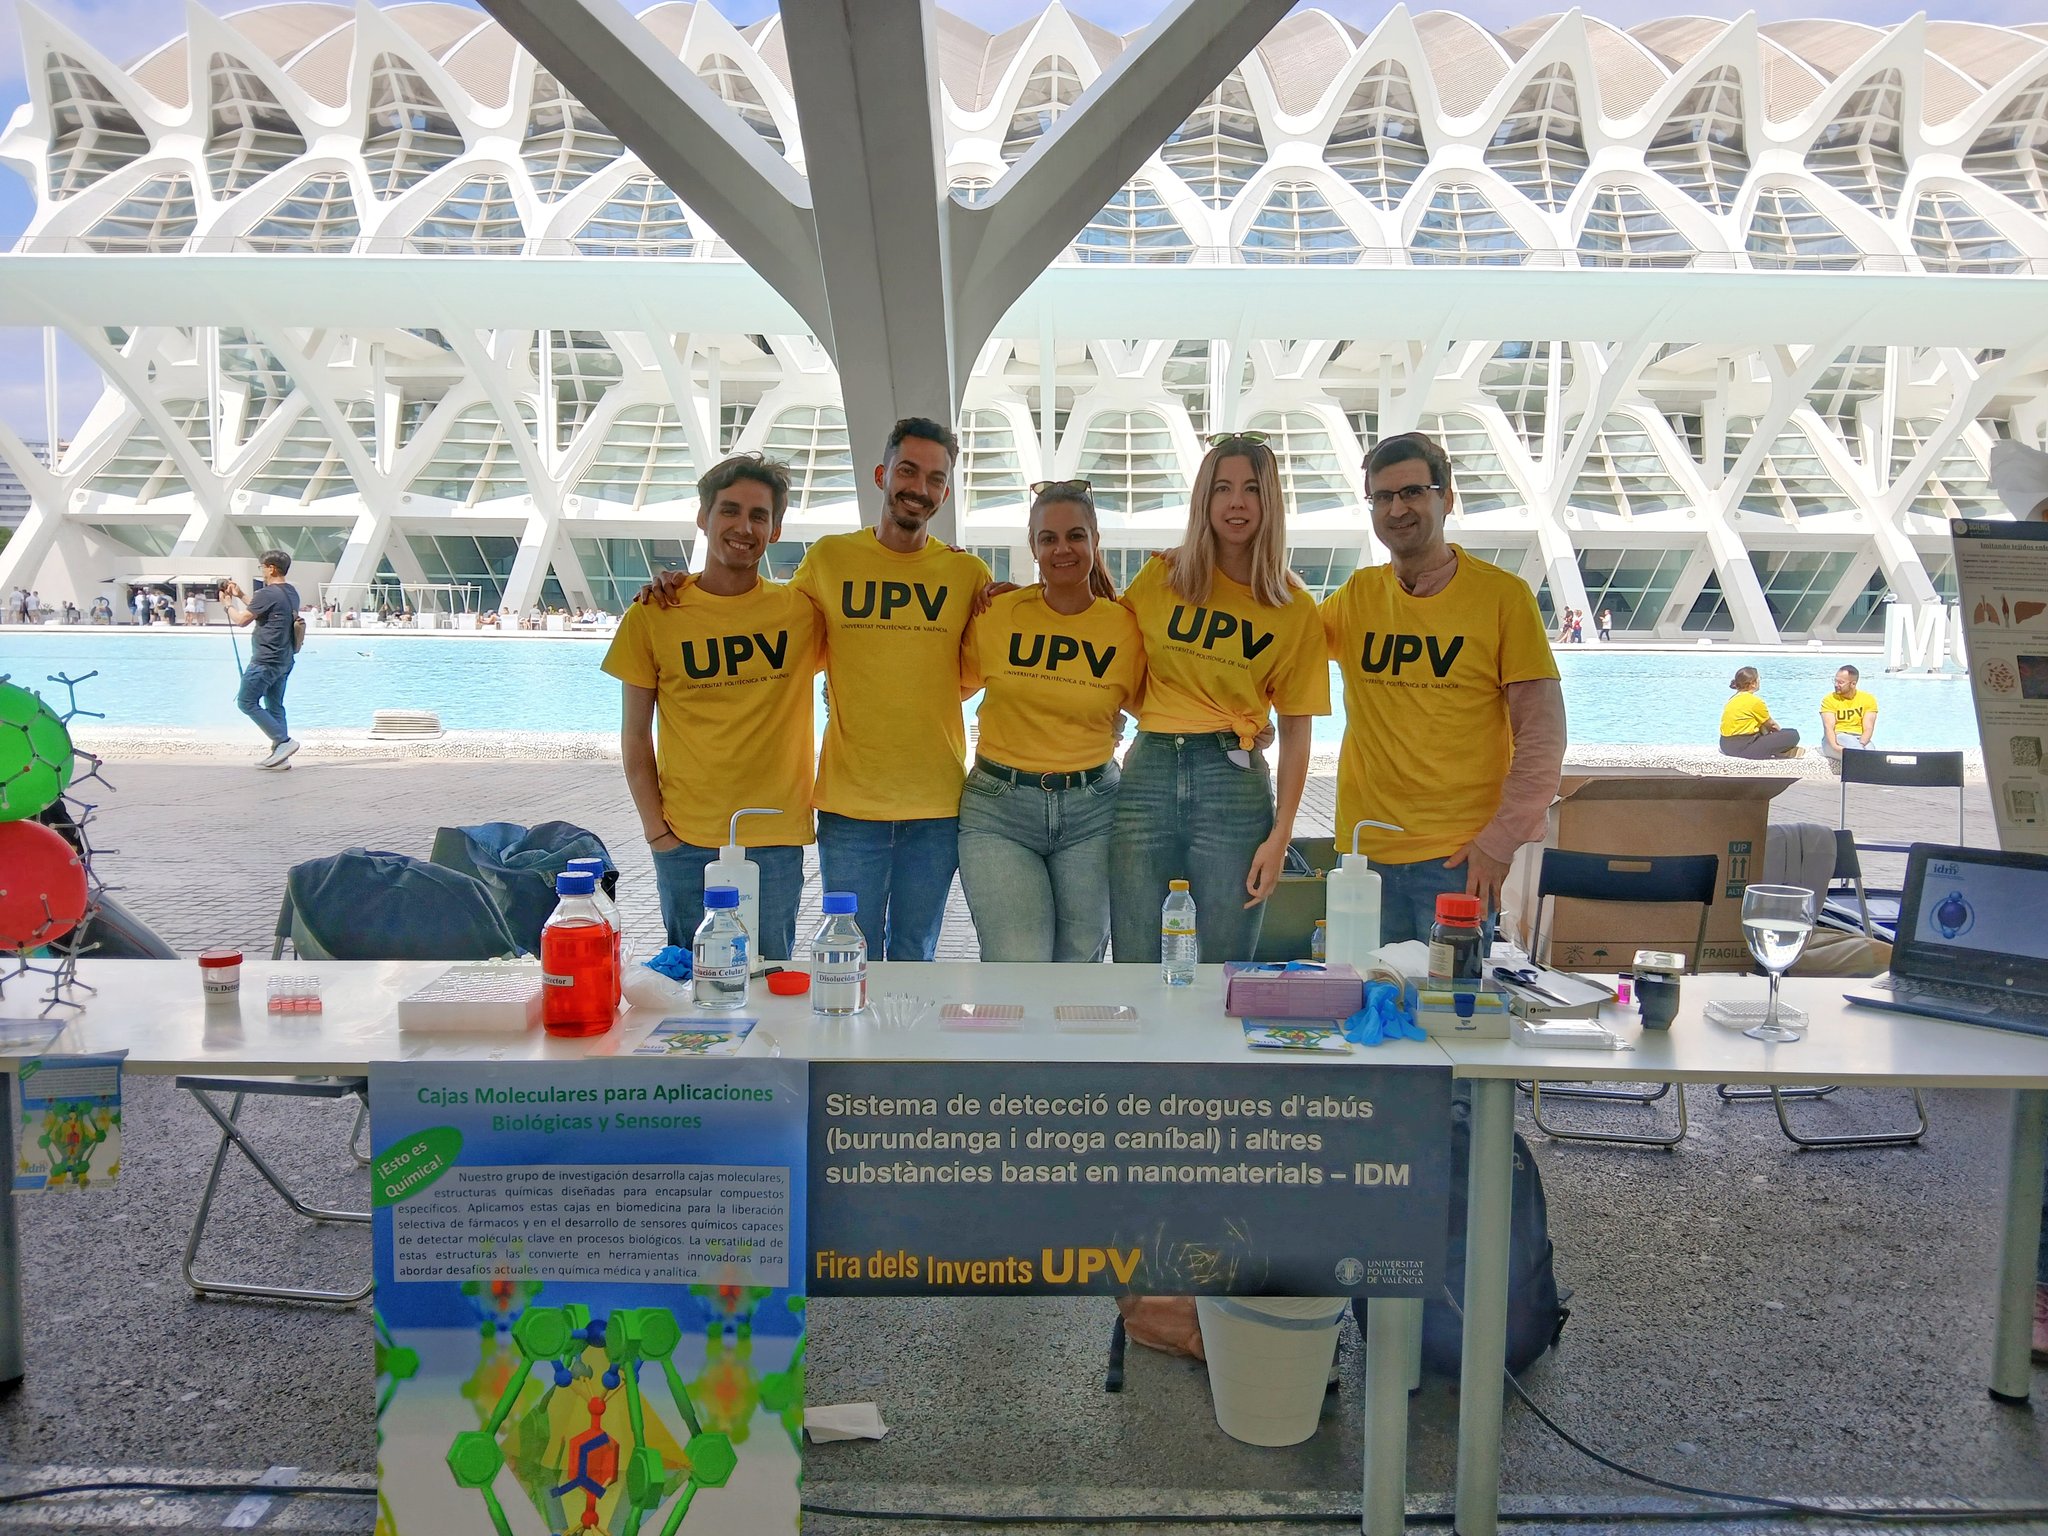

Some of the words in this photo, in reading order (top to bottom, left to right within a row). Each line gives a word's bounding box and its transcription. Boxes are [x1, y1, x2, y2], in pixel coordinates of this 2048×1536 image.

[841, 580, 948, 621] UPV
[1167, 605, 1274, 660] UPV
[681, 630, 788, 680] UPV
[1008, 632, 1116, 679] UPV
[1361, 632, 1465, 678] UPV
[1004, 670, 1038, 679] UNIVERSITAT
[687, 682, 722, 690] UNIVERSITAT
[1837, 706, 1863, 721] UPV
[1733, 844, 1748, 853] UP
[1702, 948, 1748, 960] FRAGILE
[719, 967, 744, 977] Celular
[819, 974, 856, 982] Disolución
[417, 1087, 469, 1107] Cajas
[475, 1085, 598, 1104] Moleculares
[604, 1088, 647, 1105] para
[653, 1084, 774, 1104] Aplicaciones
[825, 1093, 938, 1116] Sistema
[946, 1095, 981, 1116] de
[989, 1092, 1109, 1116] detecció
[1117, 1095, 1152, 1117] de
[1159, 1095, 1273, 1122] drogues
[1281, 1093, 1374, 1119] d'abús
[492, 1112, 593, 1134] Biológicas
[599, 1117, 610, 1133] y
[615, 1112, 702, 1130] Sensores
[826, 1127, 1001, 1154] (burundanga
[1009, 1128, 1017, 1150] i
[1025, 1128, 1106, 1153] droga
[1114, 1126, 1222, 1154] caníbal)
[1229, 1129, 1237, 1151] i
[1245, 1129, 1323, 1152] altres
[377, 1153, 410, 1180] ¡Esto
[412, 1142, 428, 1156] es
[385, 1154, 444, 1198] Química!
[459, 1173, 503, 1182] Nuestro
[506, 1172, 539, 1182] grupo
[542, 1171, 556, 1181] de
[559, 1170, 629, 1182] investigación
[632, 1170, 685, 1181] desarrolla
[688, 1171, 714, 1183] cajas
[717, 1172, 784, 1184] moleculares,
[825, 1161, 993, 1185] substàncies
[1001, 1161, 1078, 1184] basat
[1086, 1166, 1119, 1184] en
[1128, 1163, 1323, 1185] nanomaterials
[1355, 1163, 1410, 1187] IDM
[434, 1188, 497, 1198] estructuras
[505, 1186, 553, 1198] químicas
[561, 1186, 615, 1196] diseñadas
[623, 1189, 647, 1198] para
[655, 1187, 712, 1199] encapsular
[720, 1189, 784, 1200] compuestos
[398, 1203, 461, 1214] específicos.
[467, 1203, 524, 1214] Aplicamos
[530, 1203, 558, 1212] estas
[563, 1202, 590, 1214] cajas
[597, 1204, 610, 1212] en
[616, 1202, 681, 1213] biomedicina
[688, 1204, 711, 1214] para
[717, 1204, 726, 1214] la
[732, 1204, 784, 1215] liberación
[398, 1219, 445, 1229] selectiva
[450, 1218, 463, 1228] de
[469, 1218, 519, 1228] fármacos
[523, 1220, 529, 1229] y
[551, 1218, 561, 1227] el
[564, 1218, 619, 1228] desarrollo
[623, 1218, 636, 1228] de
[640, 1220, 687, 1229] sensores
[691, 1219, 738, 1231] químicos
[742, 1224, 784, 1232] capaces
[399, 1235, 412, 1245] de
[417, 1234, 463, 1244] detectar
[468, 1234, 523, 1244] moléculas
[527, 1234, 555, 1243] clave
[559, 1235, 573, 1243] en
[577, 1235, 625, 1245] procesos
[629, 1234, 684, 1246] biológicos.
[689, 1236, 700, 1245] La
[705, 1236, 766, 1247] versatilidad
[770, 1238, 783, 1248] de
[399, 1251, 427, 1260] estas
[435, 1250, 497, 1260] estructuras
[506, 1249, 521, 1259] las
[529, 1250, 579, 1259] convierte
[587, 1251, 600, 1259] en
[608, 1250, 679, 1261] herramientas
[688, 1251, 752, 1263] innovadoras
[760, 1255, 783, 1265] para
[1367, 1260, 1424, 1268] UNIVERSITAT
[400, 1266, 443, 1276] abordar
[446, 1264, 491, 1275] desafíos
[494, 1265, 539, 1275] actuales
[541, 1267, 555, 1275] en
[558, 1264, 599, 1277] química
[603, 1265, 641, 1276] médica
[644, 1269, 650, 1278] y
[653, 1266, 700, 1278] analítica.
[815, 1250, 861, 1280] Fira
[867, 1250, 919, 1279] dels
[927, 1255, 1033, 1284] Invents
[1041, 1248, 1142, 1284] UPV
[1367, 1267, 1424, 1276] POLITÈCNICA
[1367, 1276, 1377, 1284] DE
[1382, 1276, 1424, 1284] VALÈNCIA
